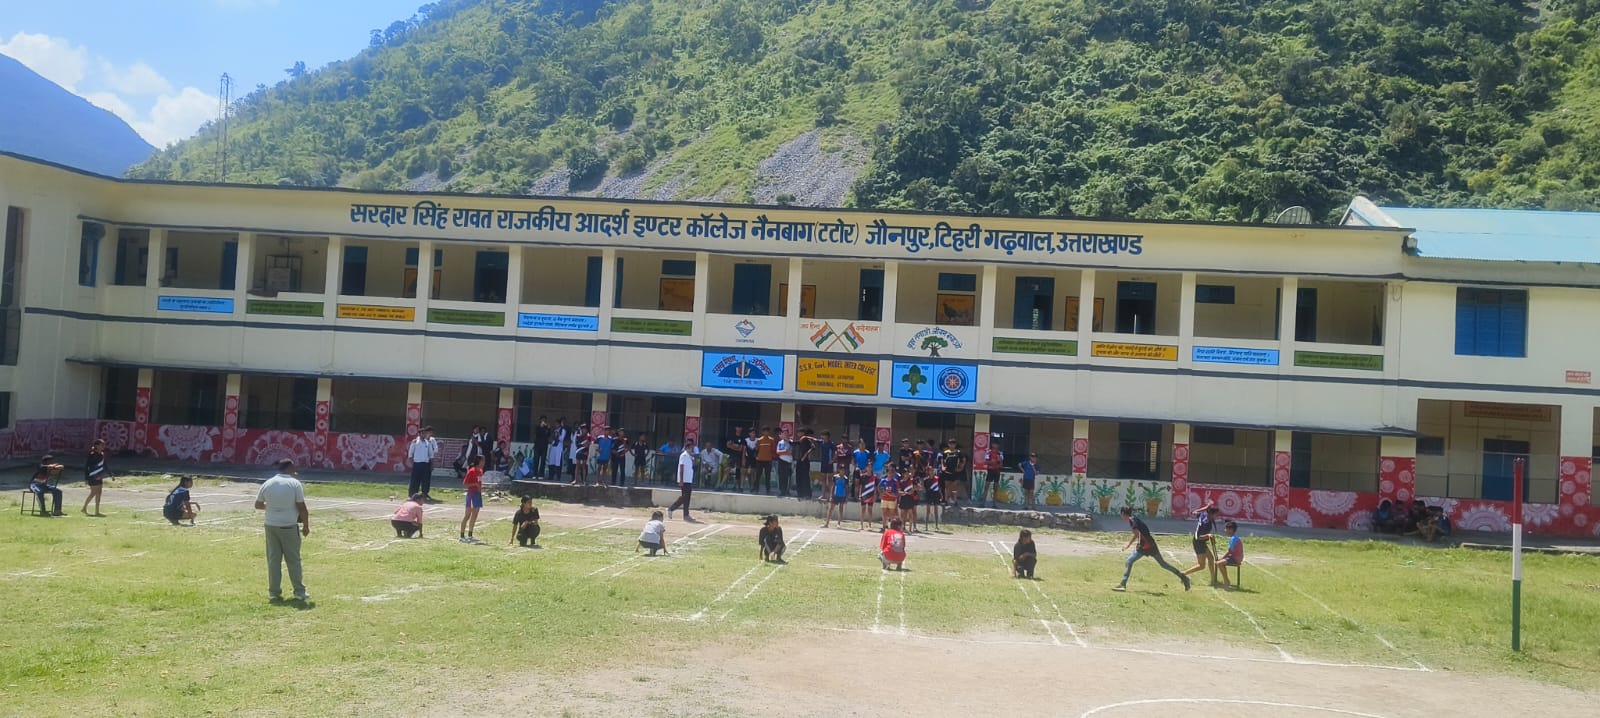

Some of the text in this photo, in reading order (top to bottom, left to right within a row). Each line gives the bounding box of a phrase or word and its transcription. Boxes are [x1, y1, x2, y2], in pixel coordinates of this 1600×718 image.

[350, 203, 409, 228] सरदार
[413, 200, 450, 230] सिंह
[452, 208, 495, 229] रावत
[497, 205, 573, 233] राजकीय
[575, 208, 630, 238] आदर्श
[633, 215, 683, 238] इण्टर
[686, 212, 748, 240] कॉलेज
